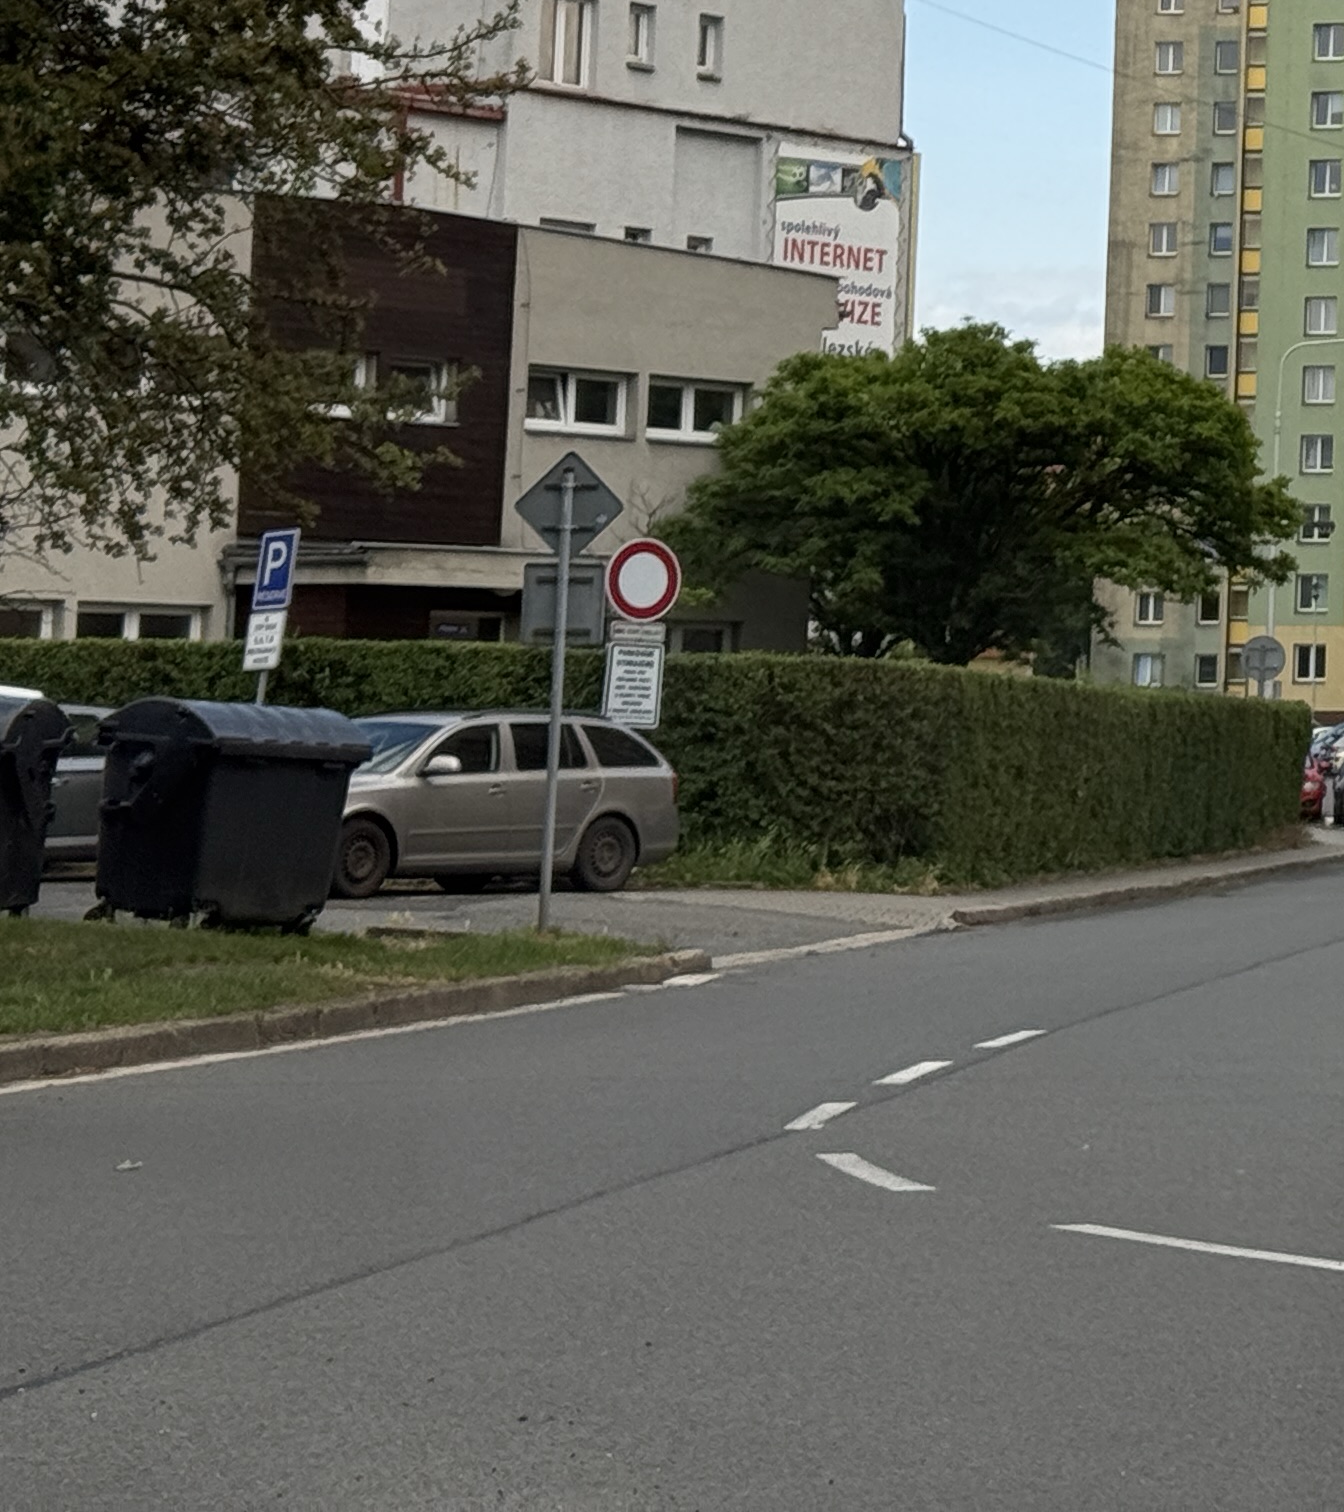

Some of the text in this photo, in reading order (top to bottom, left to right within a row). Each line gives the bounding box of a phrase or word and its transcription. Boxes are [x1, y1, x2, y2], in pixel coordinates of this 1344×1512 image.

[781, 220, 840, 240] spolehlivý
[783, 237, 888, 274] INTERNET
[263, 541, 288, 587] P
